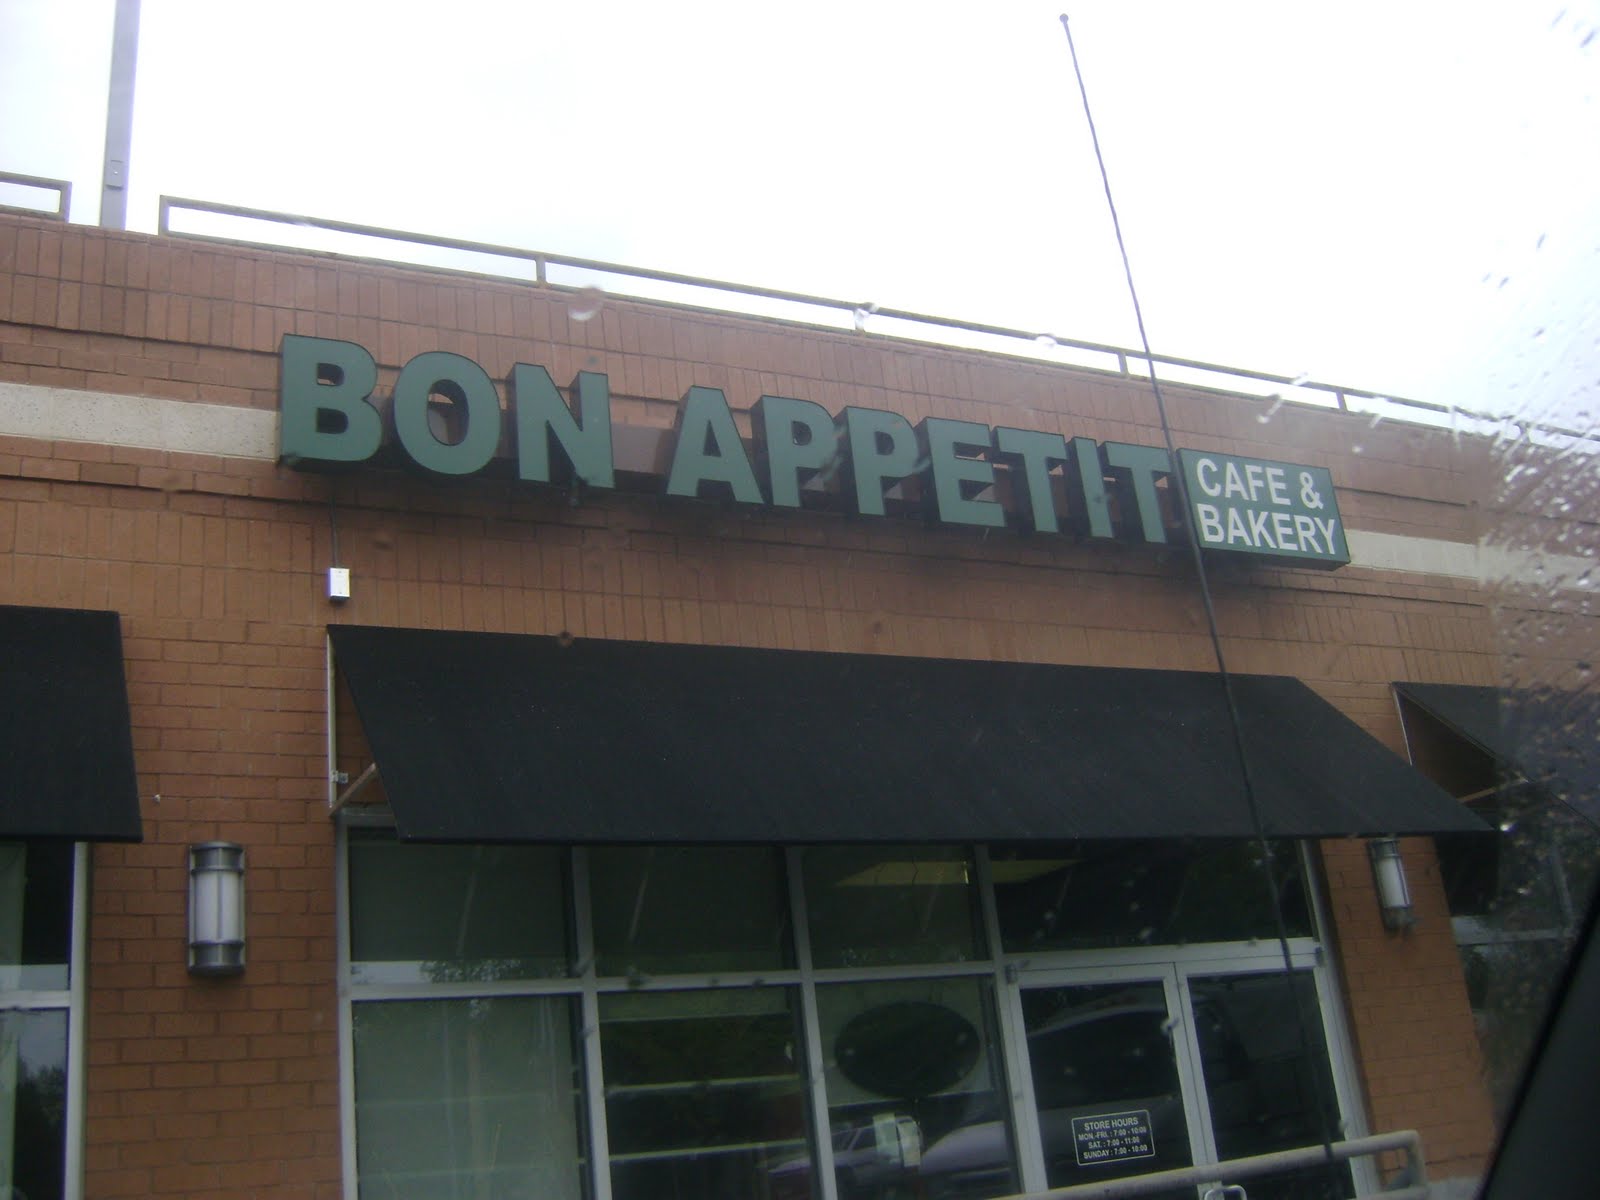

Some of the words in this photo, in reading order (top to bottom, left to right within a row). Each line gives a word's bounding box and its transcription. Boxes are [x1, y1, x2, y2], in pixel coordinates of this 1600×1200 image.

[280, 333, 615, 489] BON
[665, 385, 1171, 544] APPETIT
[1196, 458, 1291, 506] CAFE
[1299, 471, 1324, 510] &
[1197, 503, 1336, 555] BAKERY
[1084, 1120, 1110, 1131] STORE
[1111, 1117, 1139, 1128] HOURS
